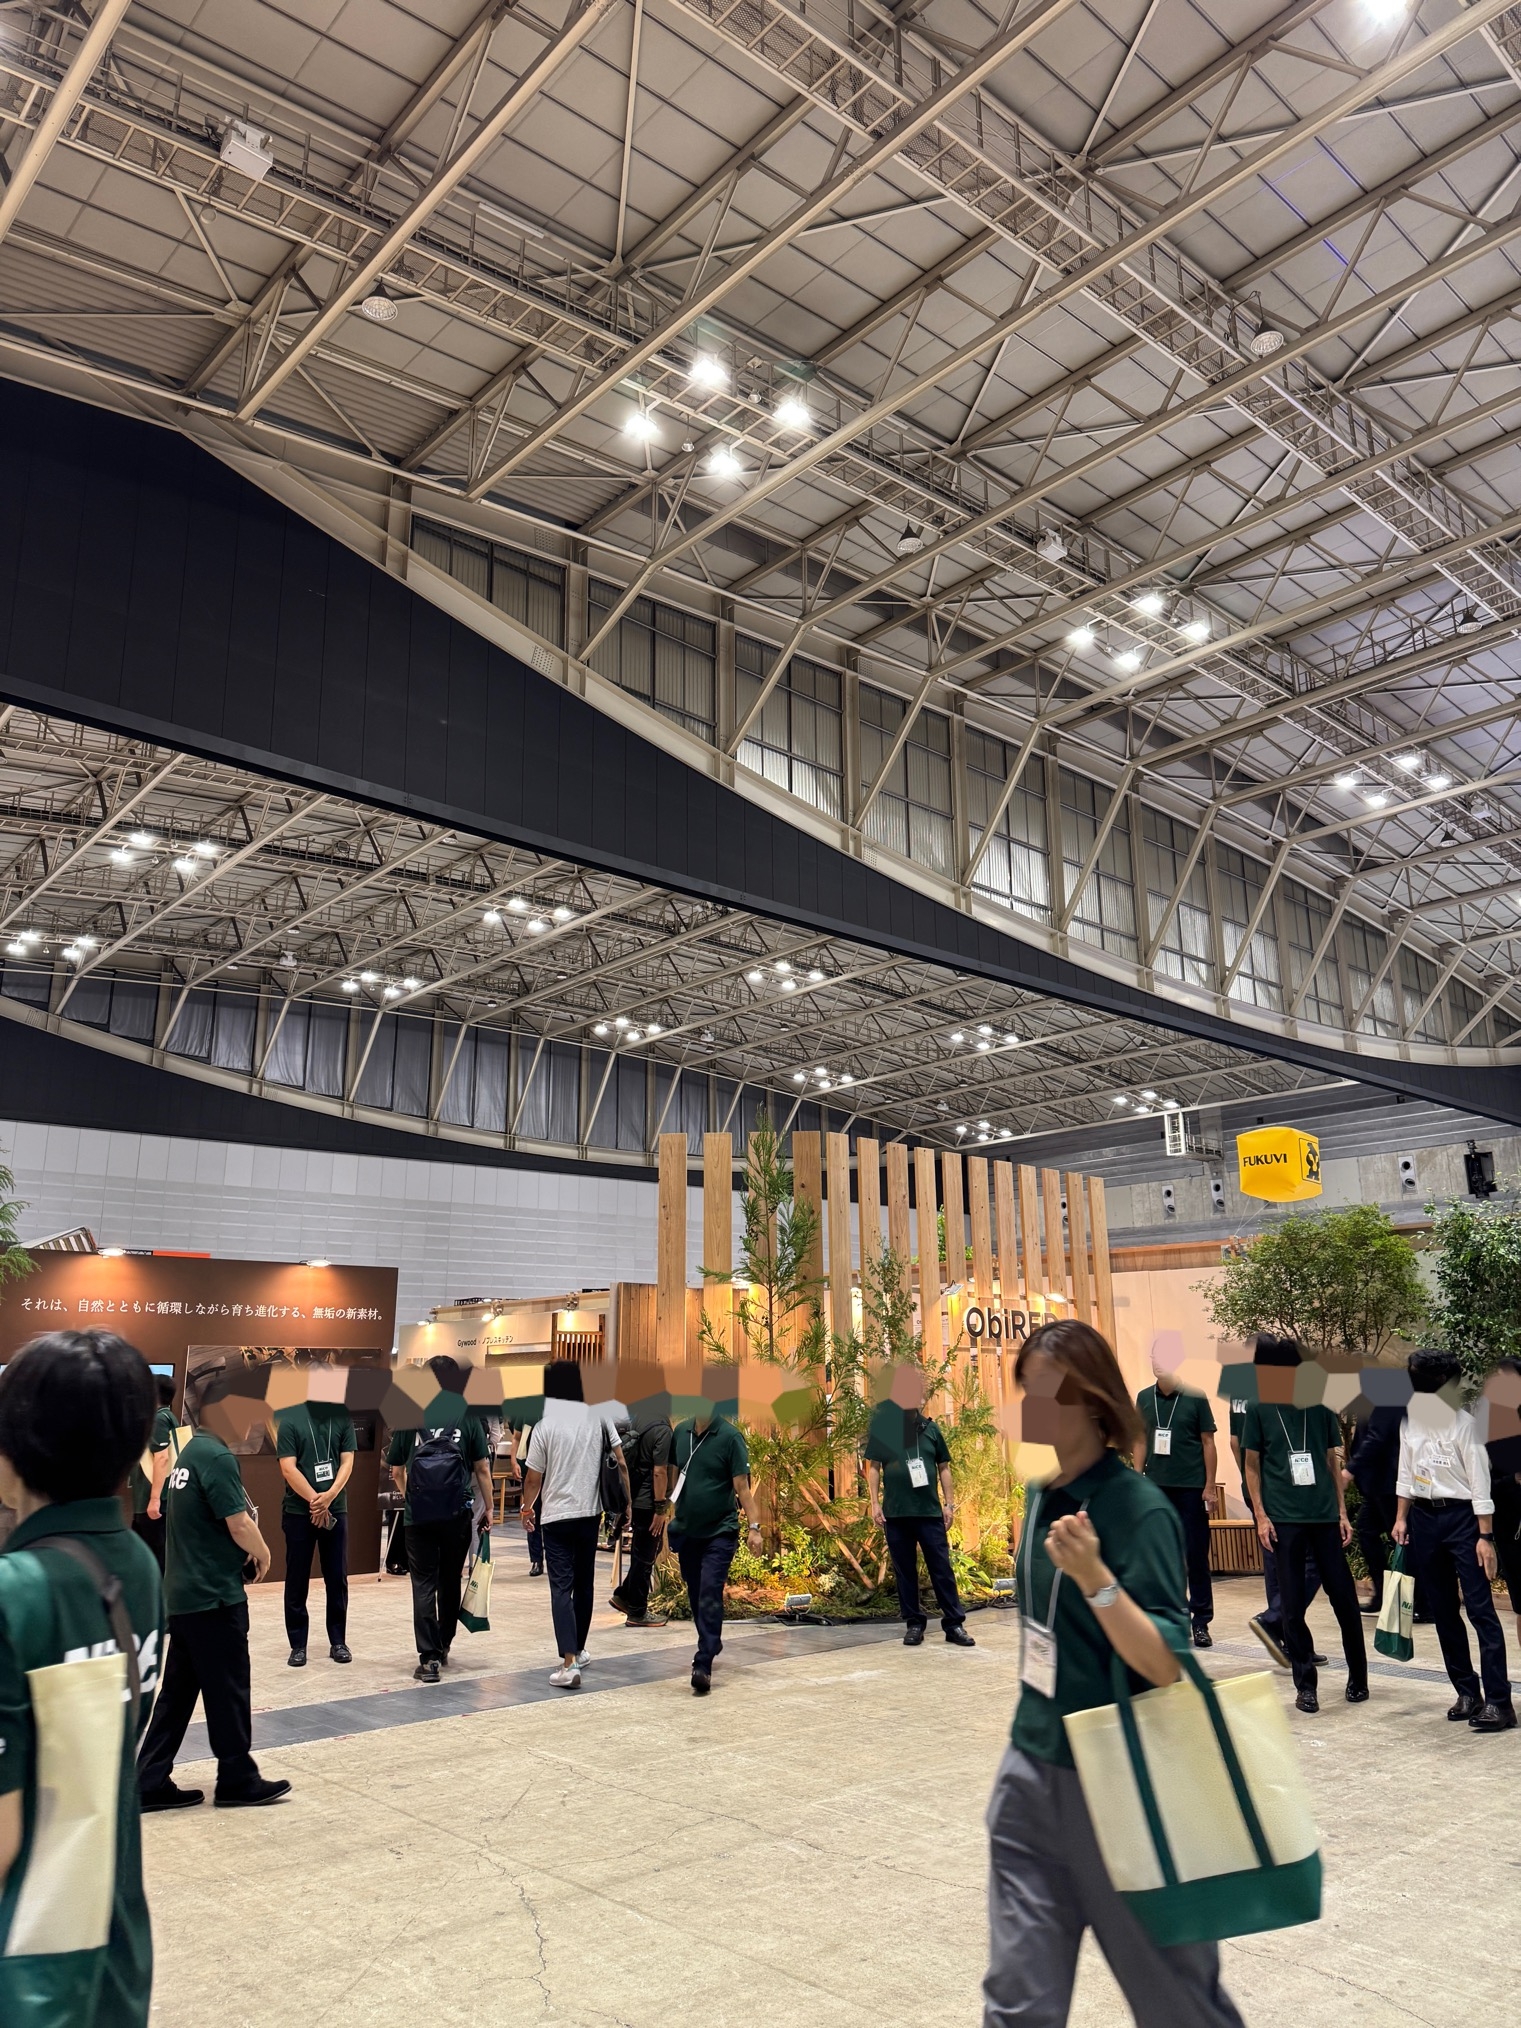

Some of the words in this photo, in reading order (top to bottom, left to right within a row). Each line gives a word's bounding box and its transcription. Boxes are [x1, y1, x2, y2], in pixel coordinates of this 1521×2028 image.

[1243, 1153, 1288, 1167] FUKUVI
[966, 1306, 1058, 1340] ObiRE
[457, 1338, 477, 1348] Gywood
